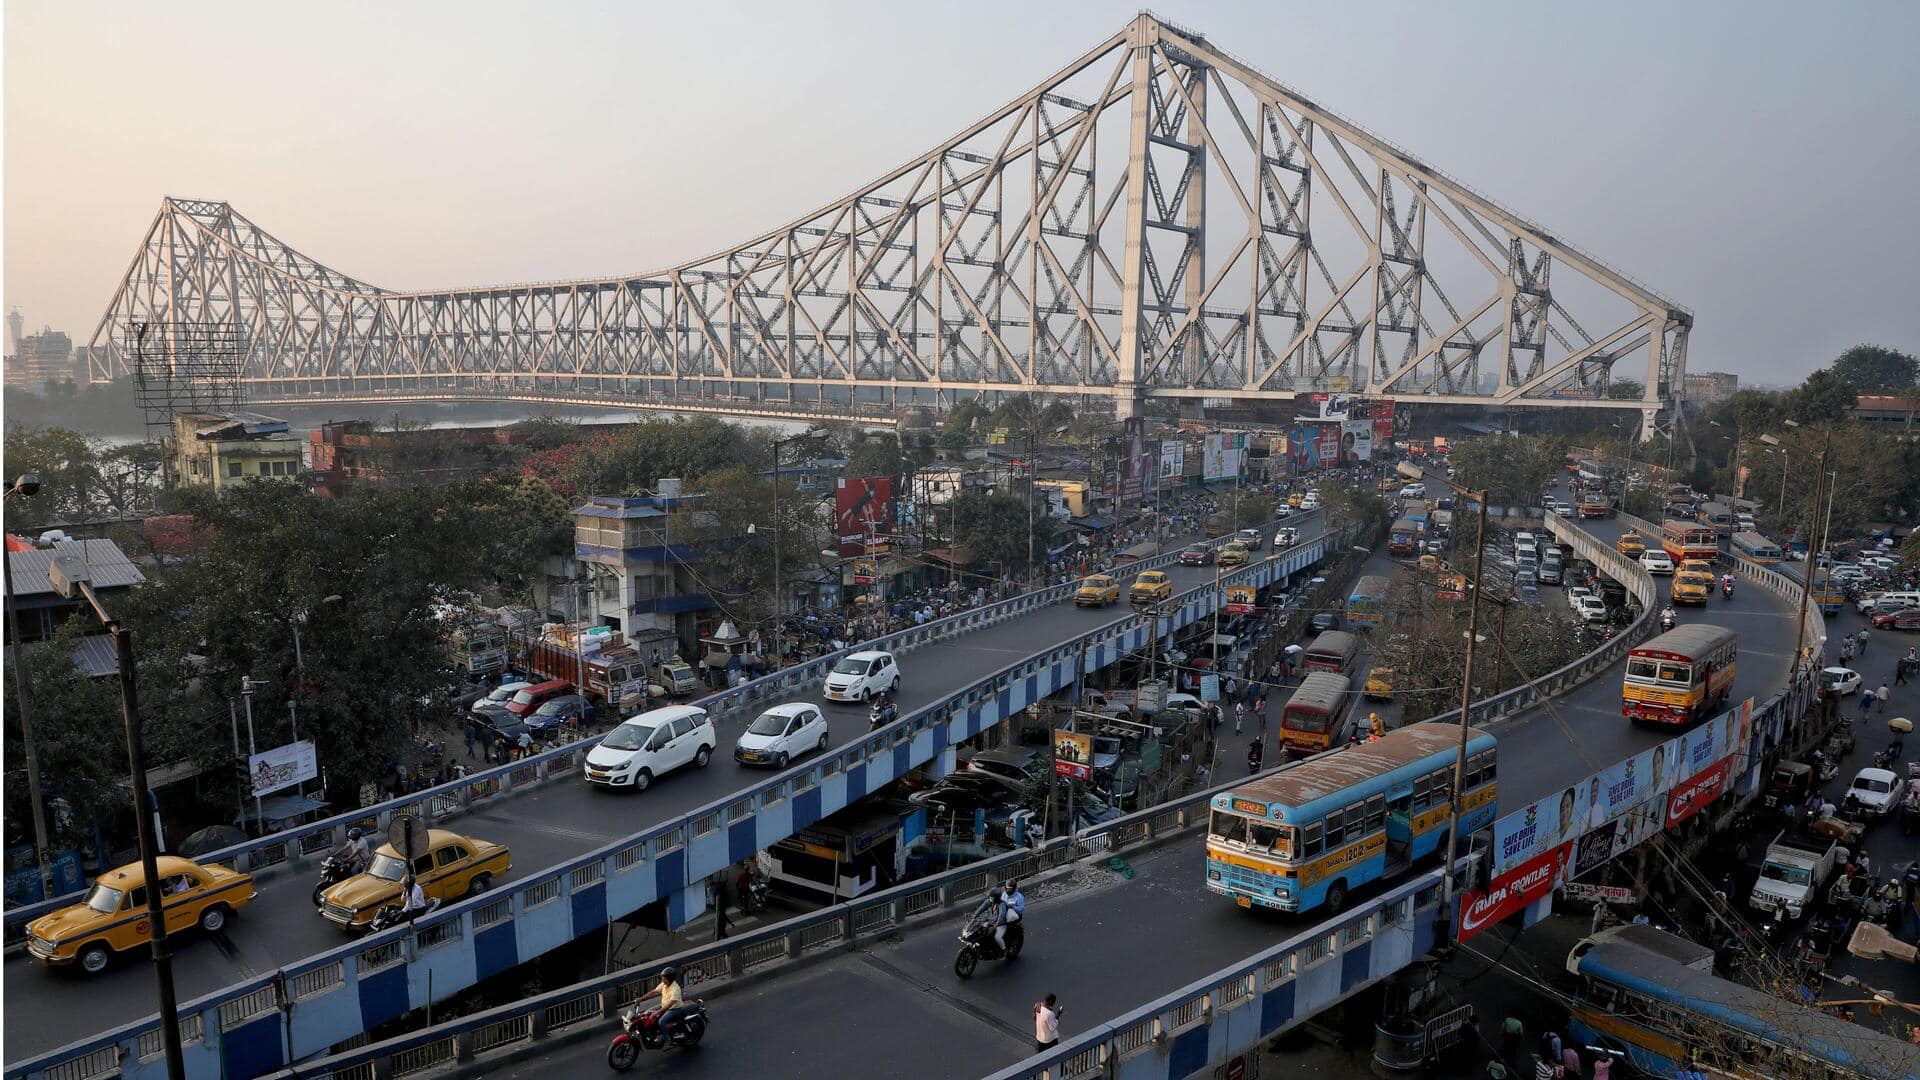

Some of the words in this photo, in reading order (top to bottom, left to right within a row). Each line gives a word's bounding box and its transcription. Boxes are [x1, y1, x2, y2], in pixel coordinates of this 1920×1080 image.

[1608, 783, 1620, 798] SAFE
[1620, 776, 1635, 791] DRIVE
[1609, 791, 1622, 806] SAVE
[1623, 786, 1634, 799] LIFE
[1503, 831, 1519, 849] SAFE
[1519, 823, 1537, 841] DRIVE
[1504, 843, 1521, 859] SAVE
[1522, 834, 1535, 850] LIFE
[1475, 888, 1507, 914] RUPA
[1510, 864, 1551, 894] FRONTLINE
